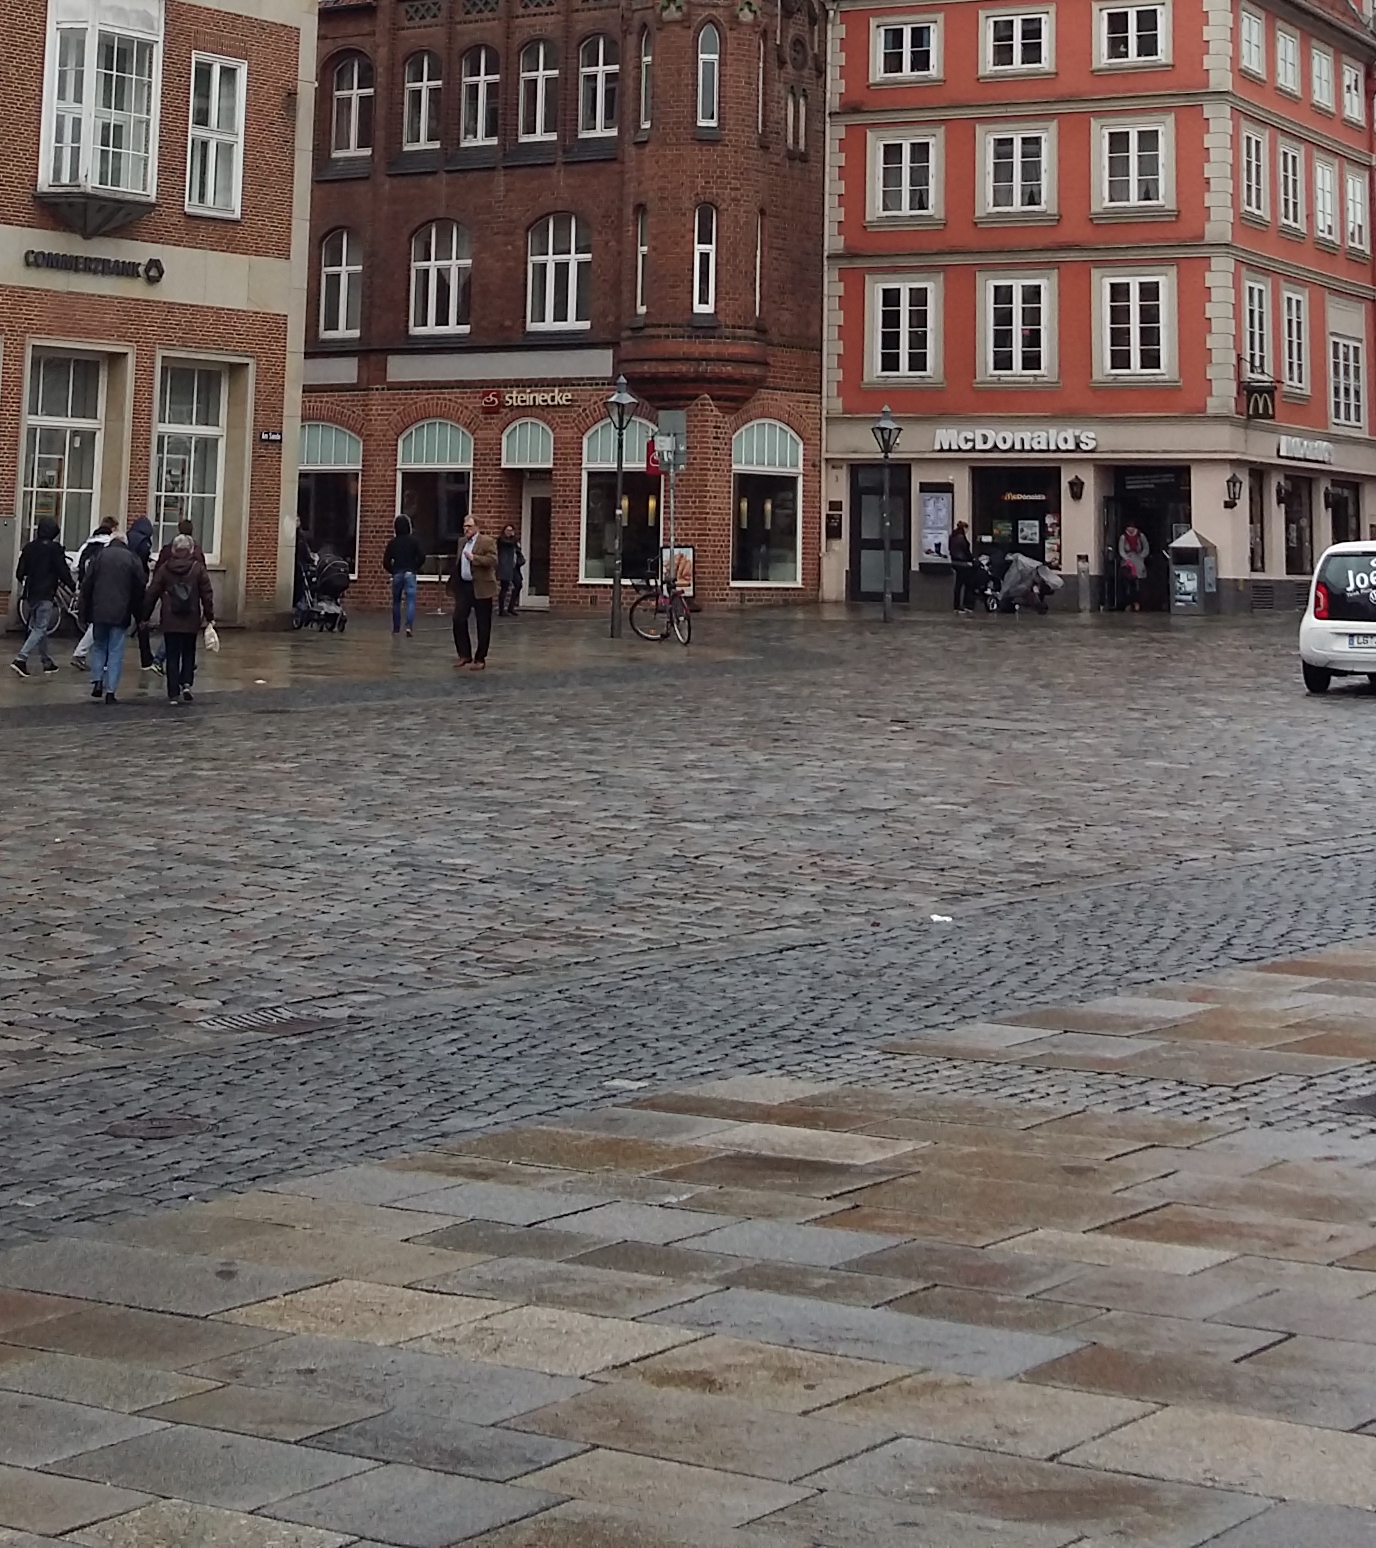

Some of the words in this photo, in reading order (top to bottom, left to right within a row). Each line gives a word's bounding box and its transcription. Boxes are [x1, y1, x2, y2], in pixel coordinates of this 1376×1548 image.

[25, 250, 141, 278] COMMERZBANK
[504, 388, 572, 407] steinecke
[934, 428, 1097, 451] McDonald's
